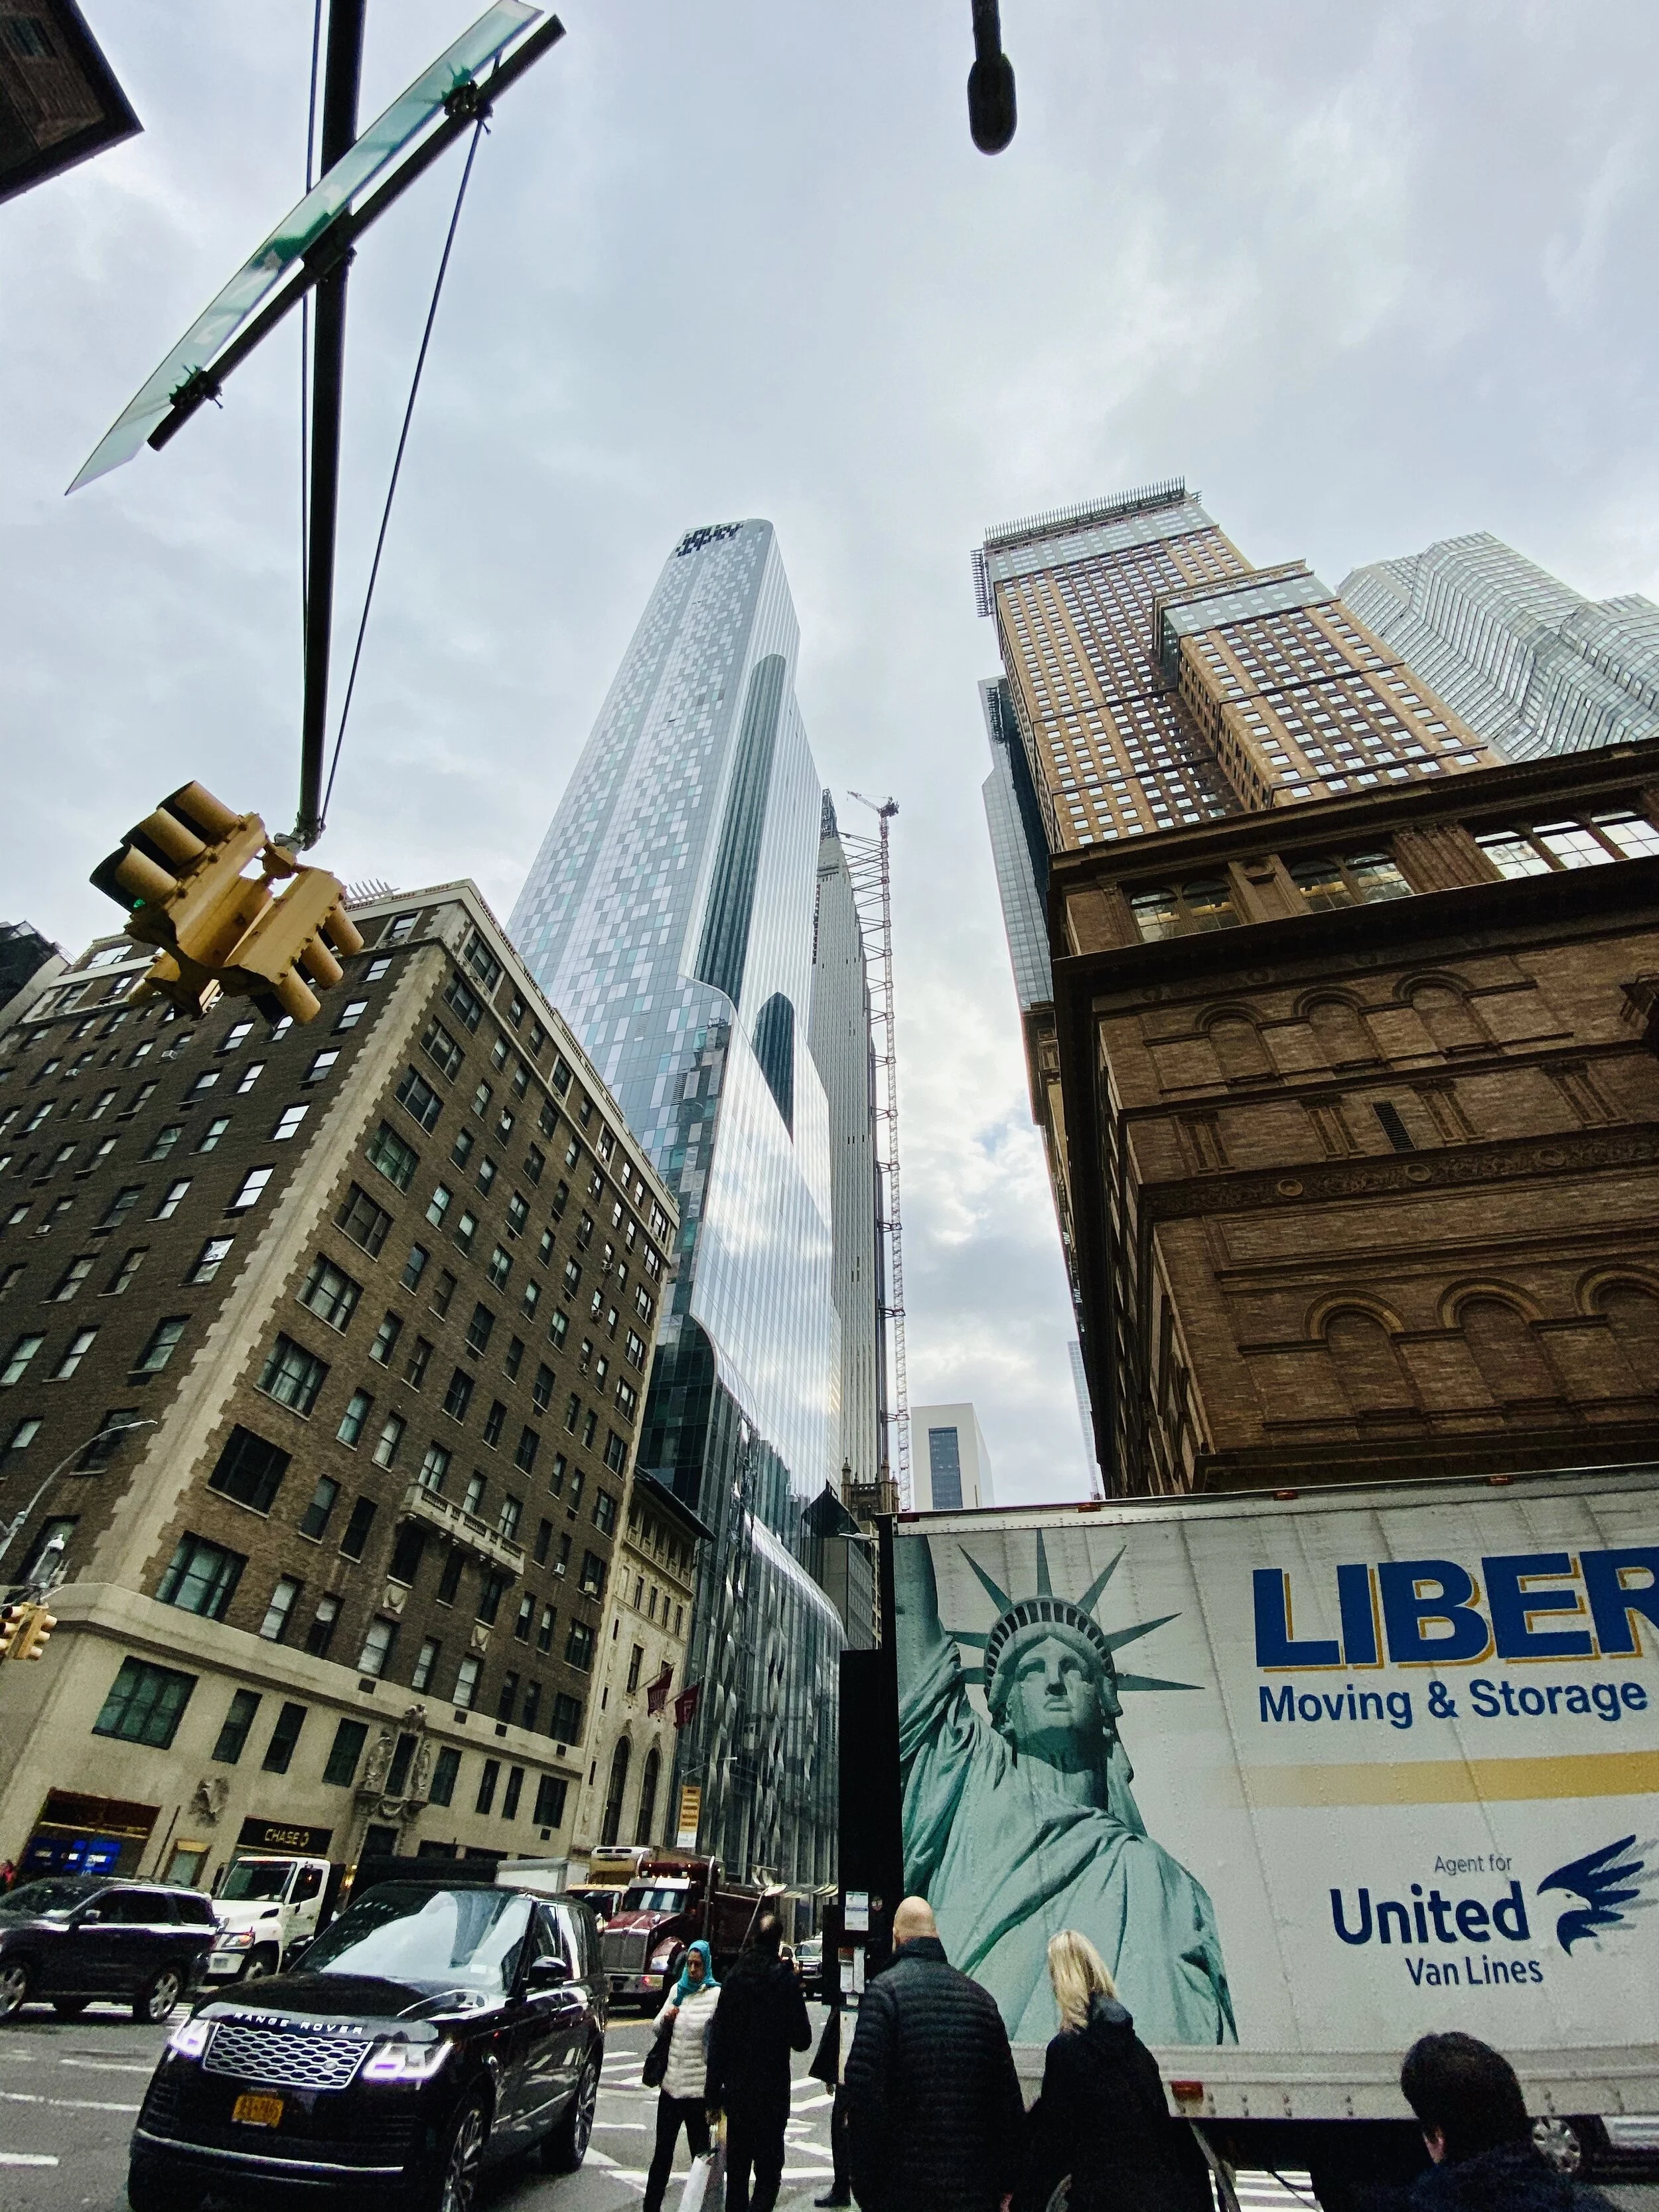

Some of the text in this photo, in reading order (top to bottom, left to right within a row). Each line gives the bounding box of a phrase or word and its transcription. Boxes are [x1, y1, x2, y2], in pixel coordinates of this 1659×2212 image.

[1253, 1546, 1659, 1672] LIBER
[1259, 1679, 1649, 1730] Moving & Storage
[265, 1828, 300, 1845] CHASE
[1434, 1854, 1513, 1876] Agent for
[1329, 1880, 1531, 1945] United
[1405, 1954, 1544, 1987] Van Lines
[234, 2012, 363, 2035] RANGE ROVER
